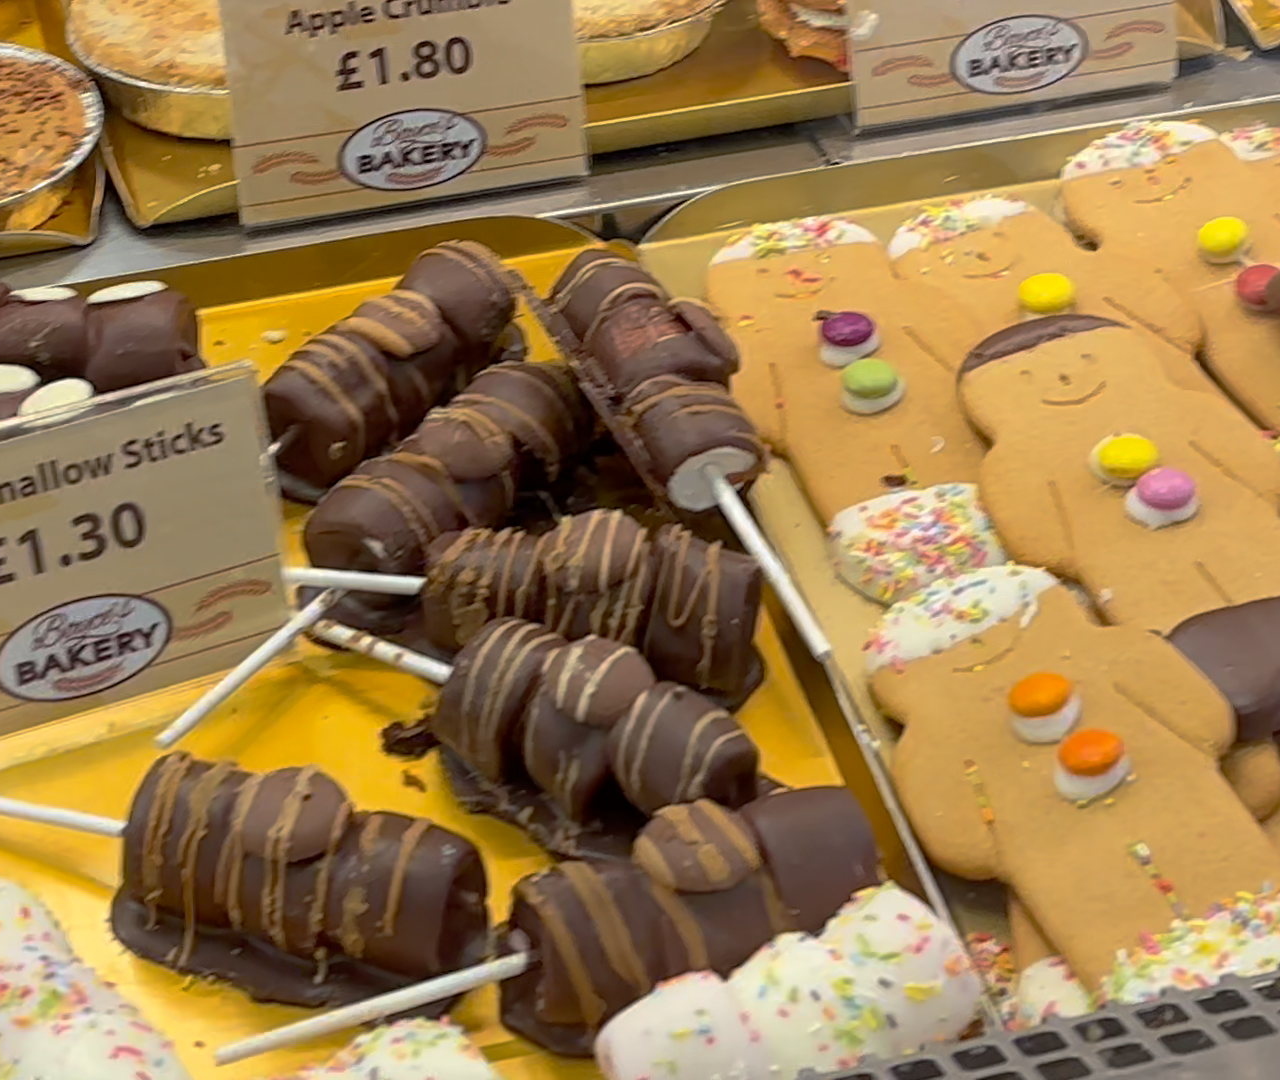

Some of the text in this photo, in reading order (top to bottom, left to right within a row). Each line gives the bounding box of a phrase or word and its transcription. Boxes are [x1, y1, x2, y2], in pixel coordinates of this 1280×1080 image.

[335, 35, 474, 93] £1.80
[966, 42, 1079, 79] BAKERY
[355, 137, 479, 175] BAKERY
[120, 419, 227, 471] Sticks
[14, 621, 161, 687] BAKERY
